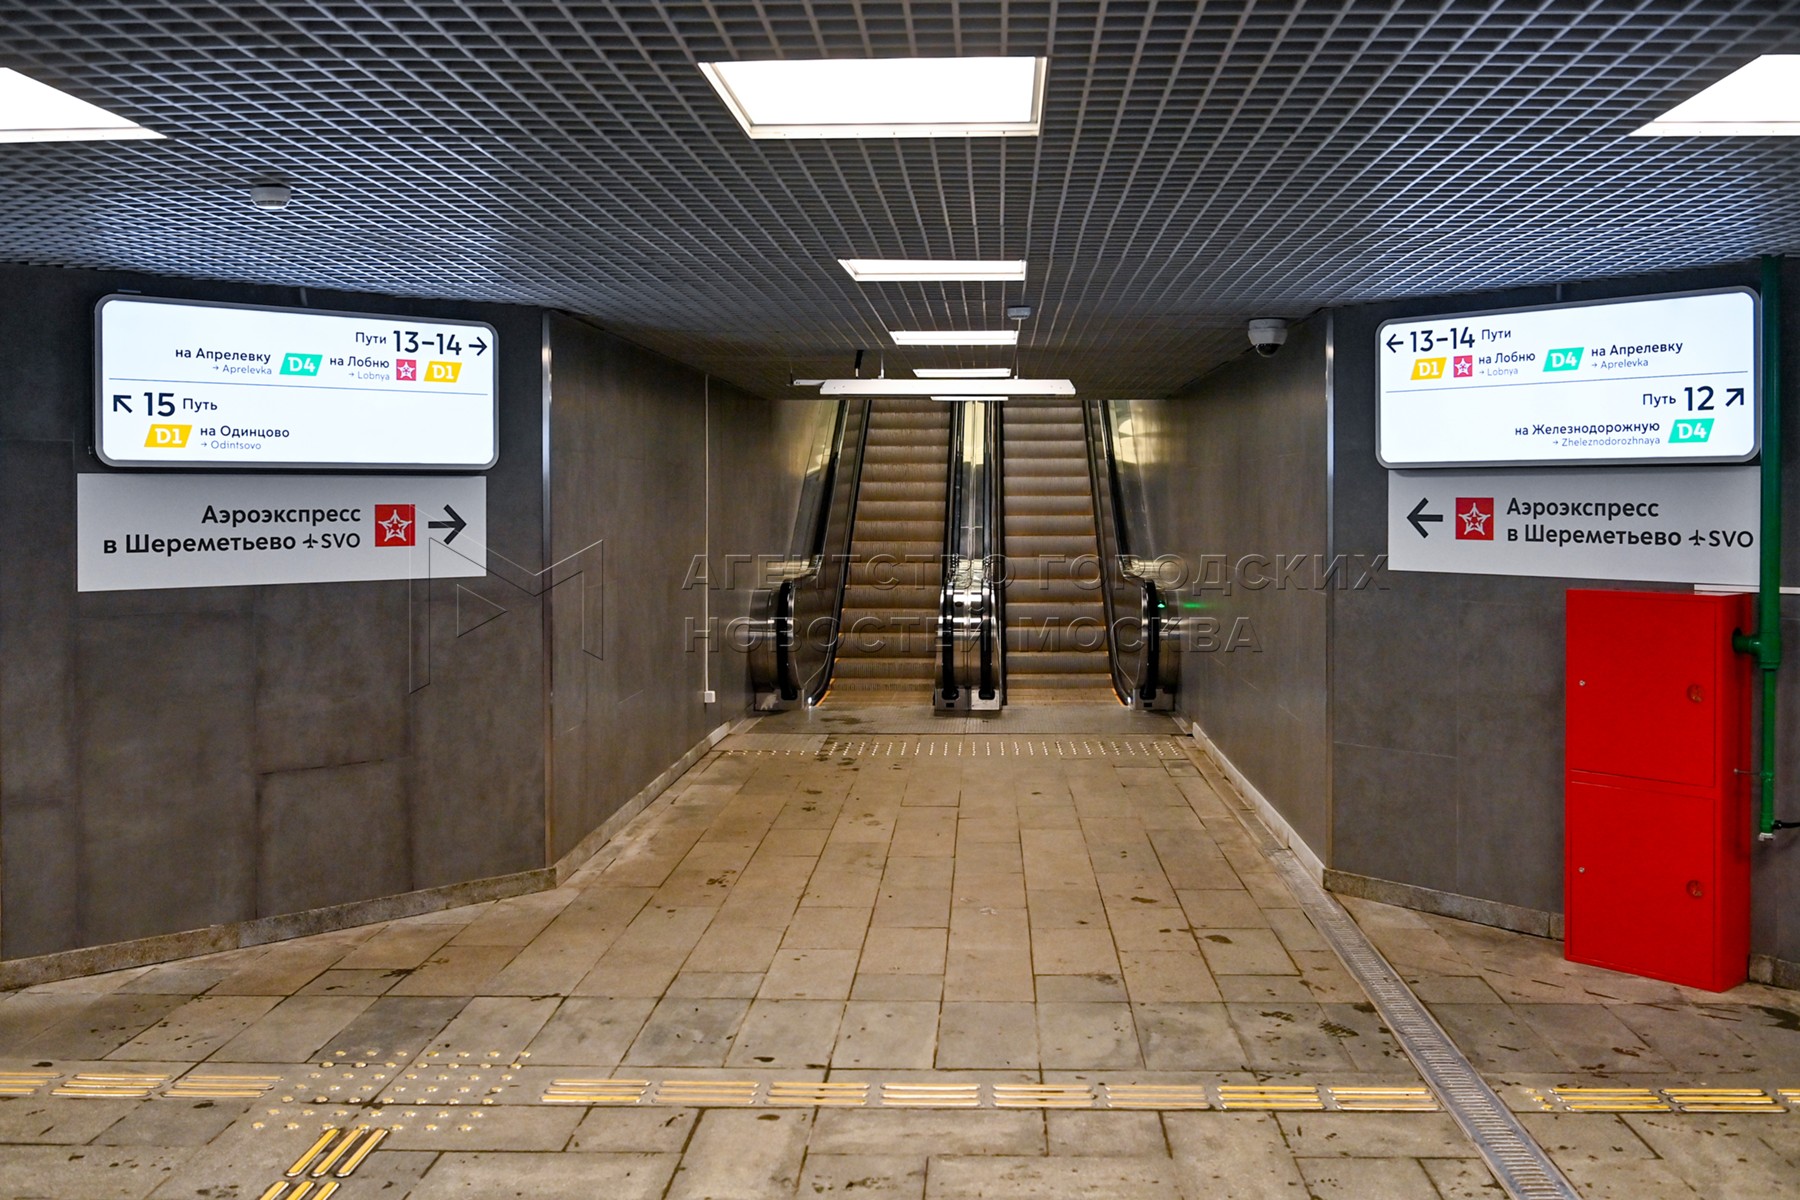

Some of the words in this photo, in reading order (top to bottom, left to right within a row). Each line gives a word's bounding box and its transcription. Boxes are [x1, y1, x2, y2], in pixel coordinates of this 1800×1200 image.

[355, 332, 387, 346] Пути
[1481, 329, 1511, 342] Пути
[175, 349, 191, 359] на
[195, 348, 271, 364] Апрелевку
[288, 357, 316, 373] D4
[329, 356, 344, 366] на
[347, 356, 390, 368] Лобню
[432, 364, 454, 380] D1
[1418, 361, 1440, 377] D1
[1478, 356, 1492, 364] на
[1495, 351, 1536, 363] Лобню
[1551, 352, 1577, 368] D4
[1591, 347, 1606, 357] на
[1609, 341, 1683, 357] Апрелевку
[1600, 358, 1649, 370] Aprelevka
[222, 365, 272, 375] Aprelevka
[357, 371, 390, 381] Lobnya
[1487, 367, 1518, 377] Lobnya
[143, 392, 176, 417] 15
[183, 398, 218, 413] Путь
[1642, 393, 1676, 408] Путь
[1684, 385, 1715, 411] 12
[155, 428, 183, 444] D1
[200, 427, 216, 437] на
[220, 425, 290, 438] Одинцово
[1515, 425, 1529, 436] на
[1532, 420, 1661, 436] Железнодорожную
[1677, 423, 1707, 439] D4
[211, 440, 262, 450] Odintsovo
[1561, 436, 1661, 447] Zheleznodorozhnaya
[201, 505, 361, 528] Аэроэкспресс
[1507, 497, 1659, 521] Аэроэкспресс
[103, 540, 117, 554] в
[126, 534, 296, 557] Шереметьево
[321, 533, 361, 549] SVO
[1507, 529, 1518, 542] в
[1525, 524, 1682, 547] Шереметьево
[1708, 530, 1754, 548] SVO
